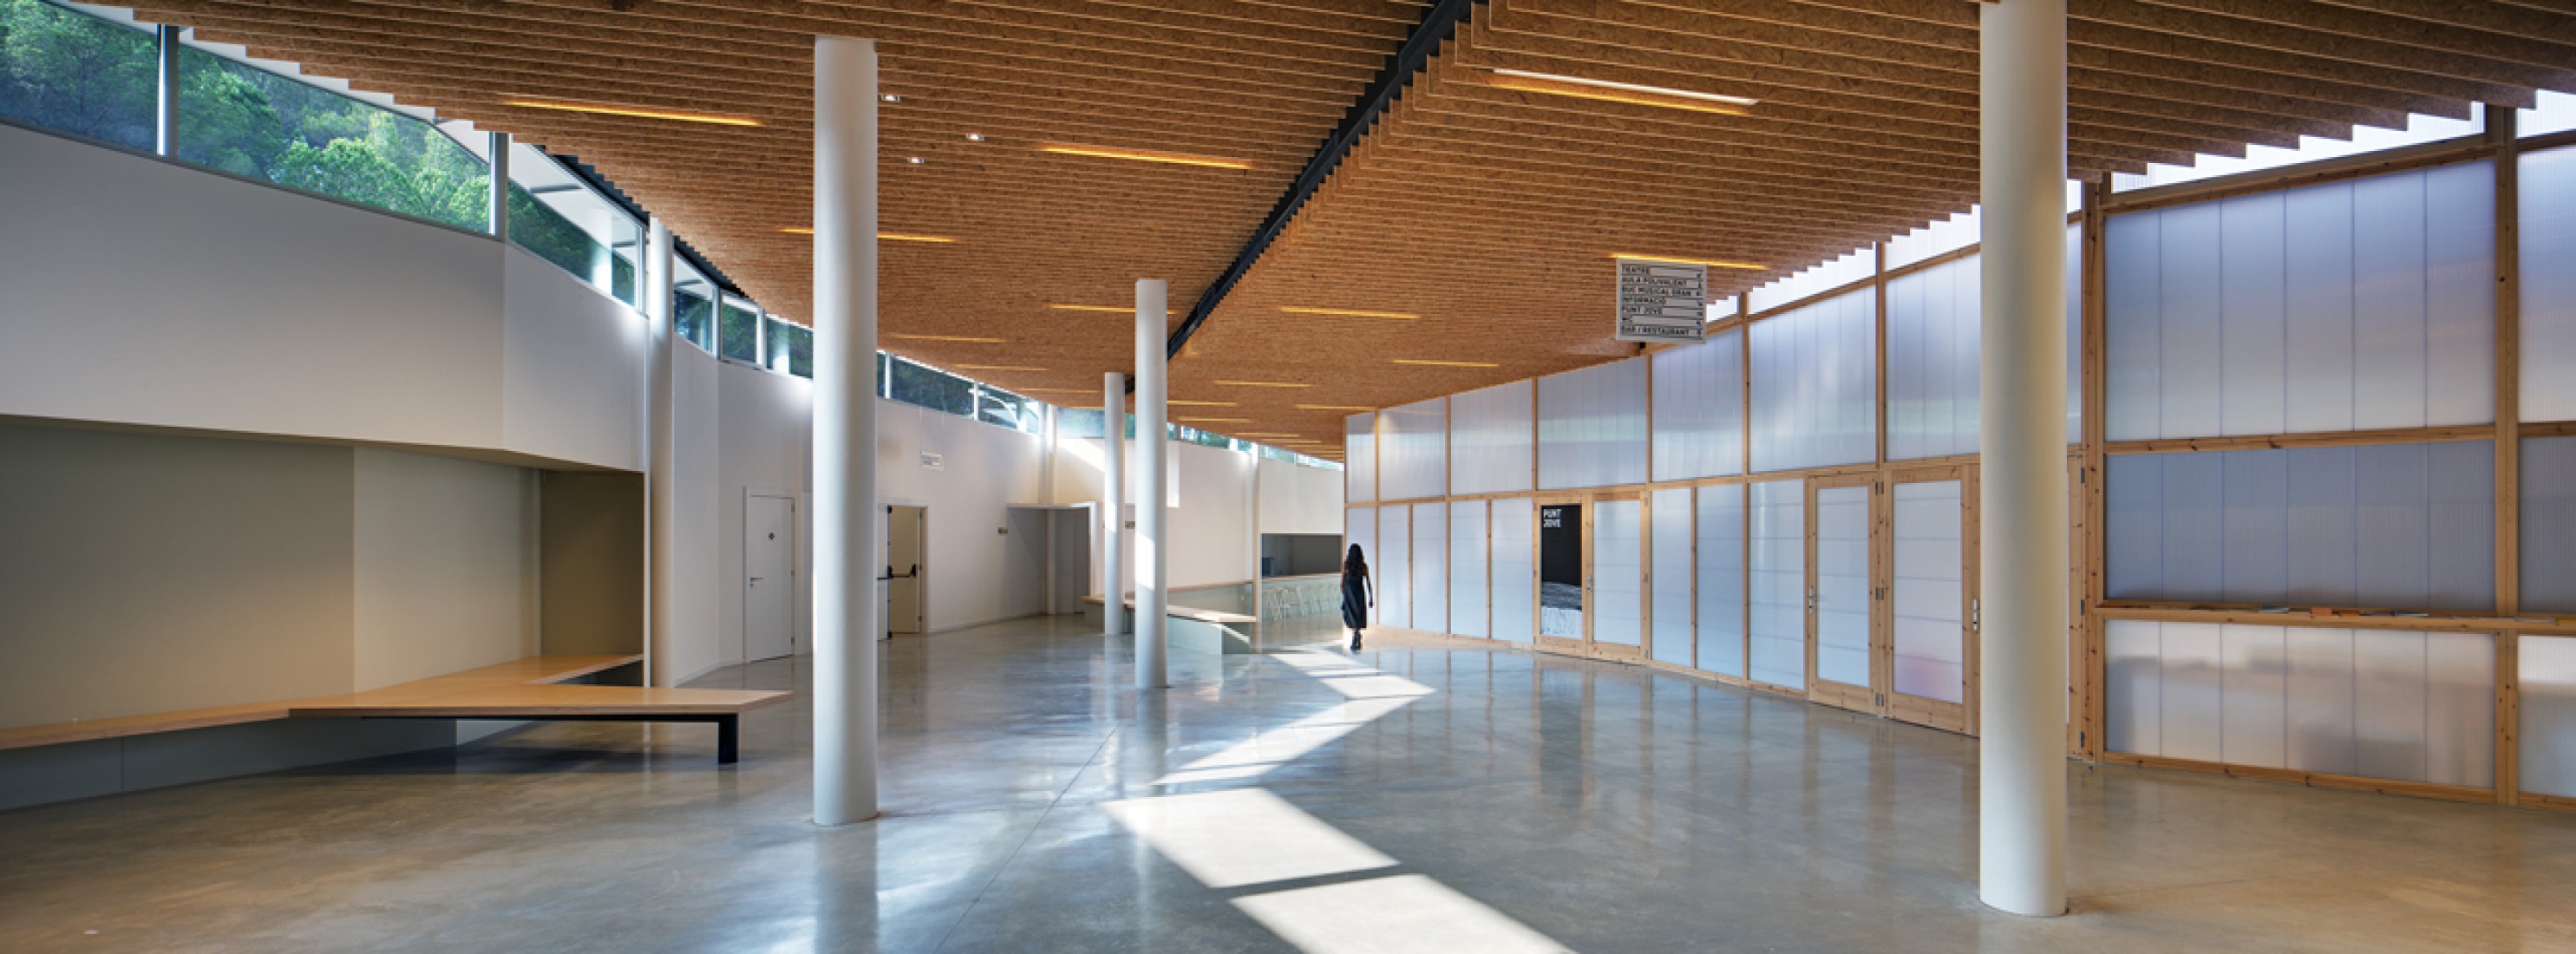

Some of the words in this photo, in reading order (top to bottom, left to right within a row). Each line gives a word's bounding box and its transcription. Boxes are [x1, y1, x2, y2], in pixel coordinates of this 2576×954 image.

[1622, 265, 1650, 274] TEATRE
[1643, 327, 1688, 336] RESTAURANT
[1543, 508, 1562, 518] PUNT
[1543, 519, 1561, 528] JOVE
